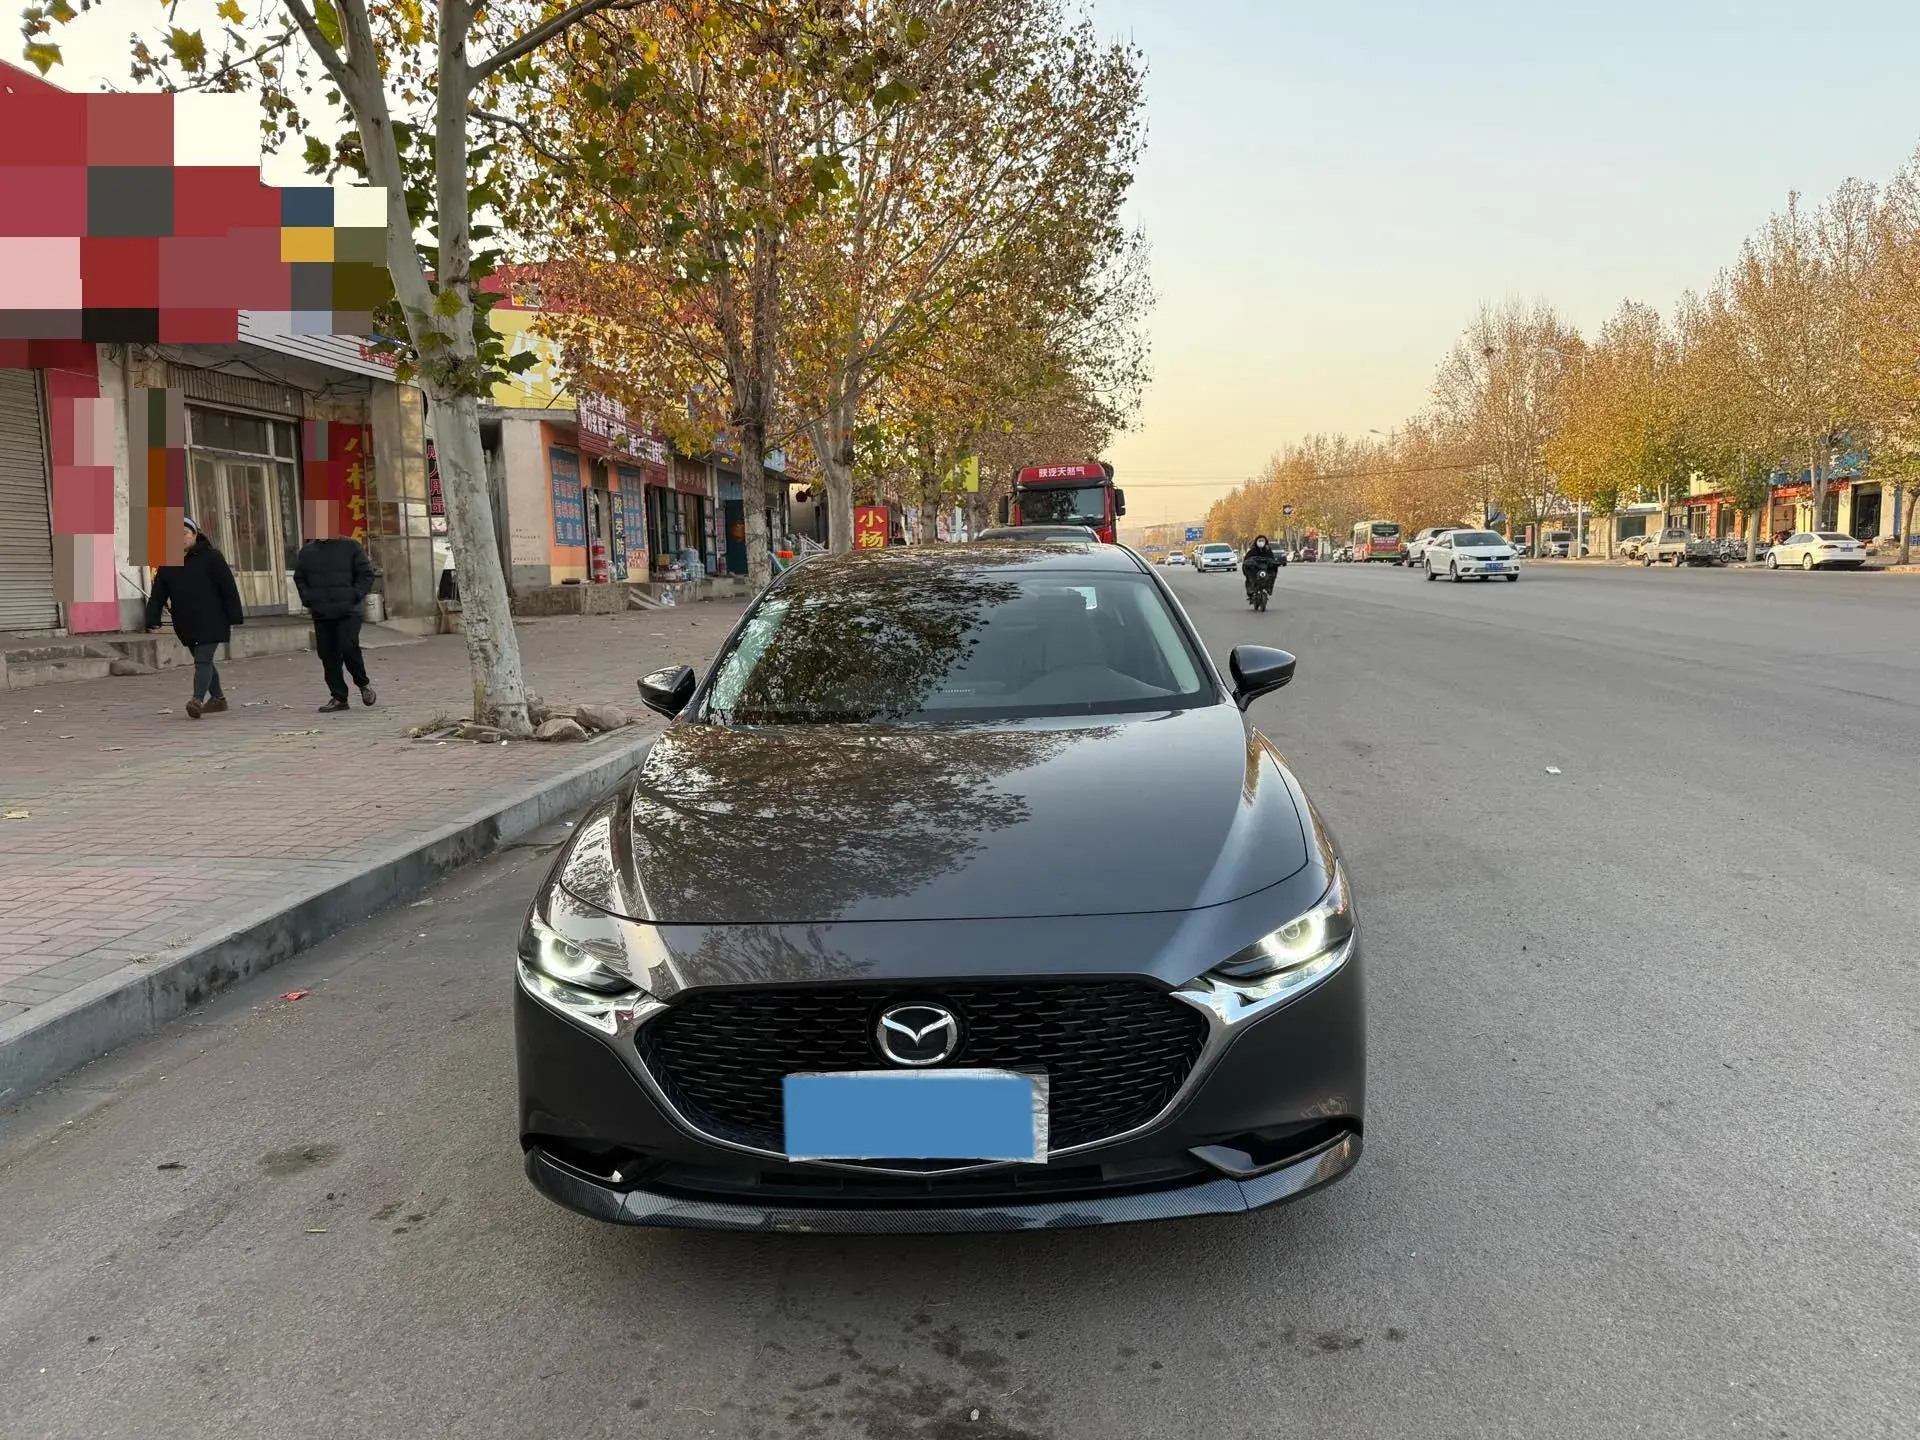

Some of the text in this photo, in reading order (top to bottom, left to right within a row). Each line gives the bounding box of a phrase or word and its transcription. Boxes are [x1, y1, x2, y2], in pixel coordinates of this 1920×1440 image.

[1039, 466, 1085, 478] 陕汽天然气
[858, 510, 884, 547] 小杨
